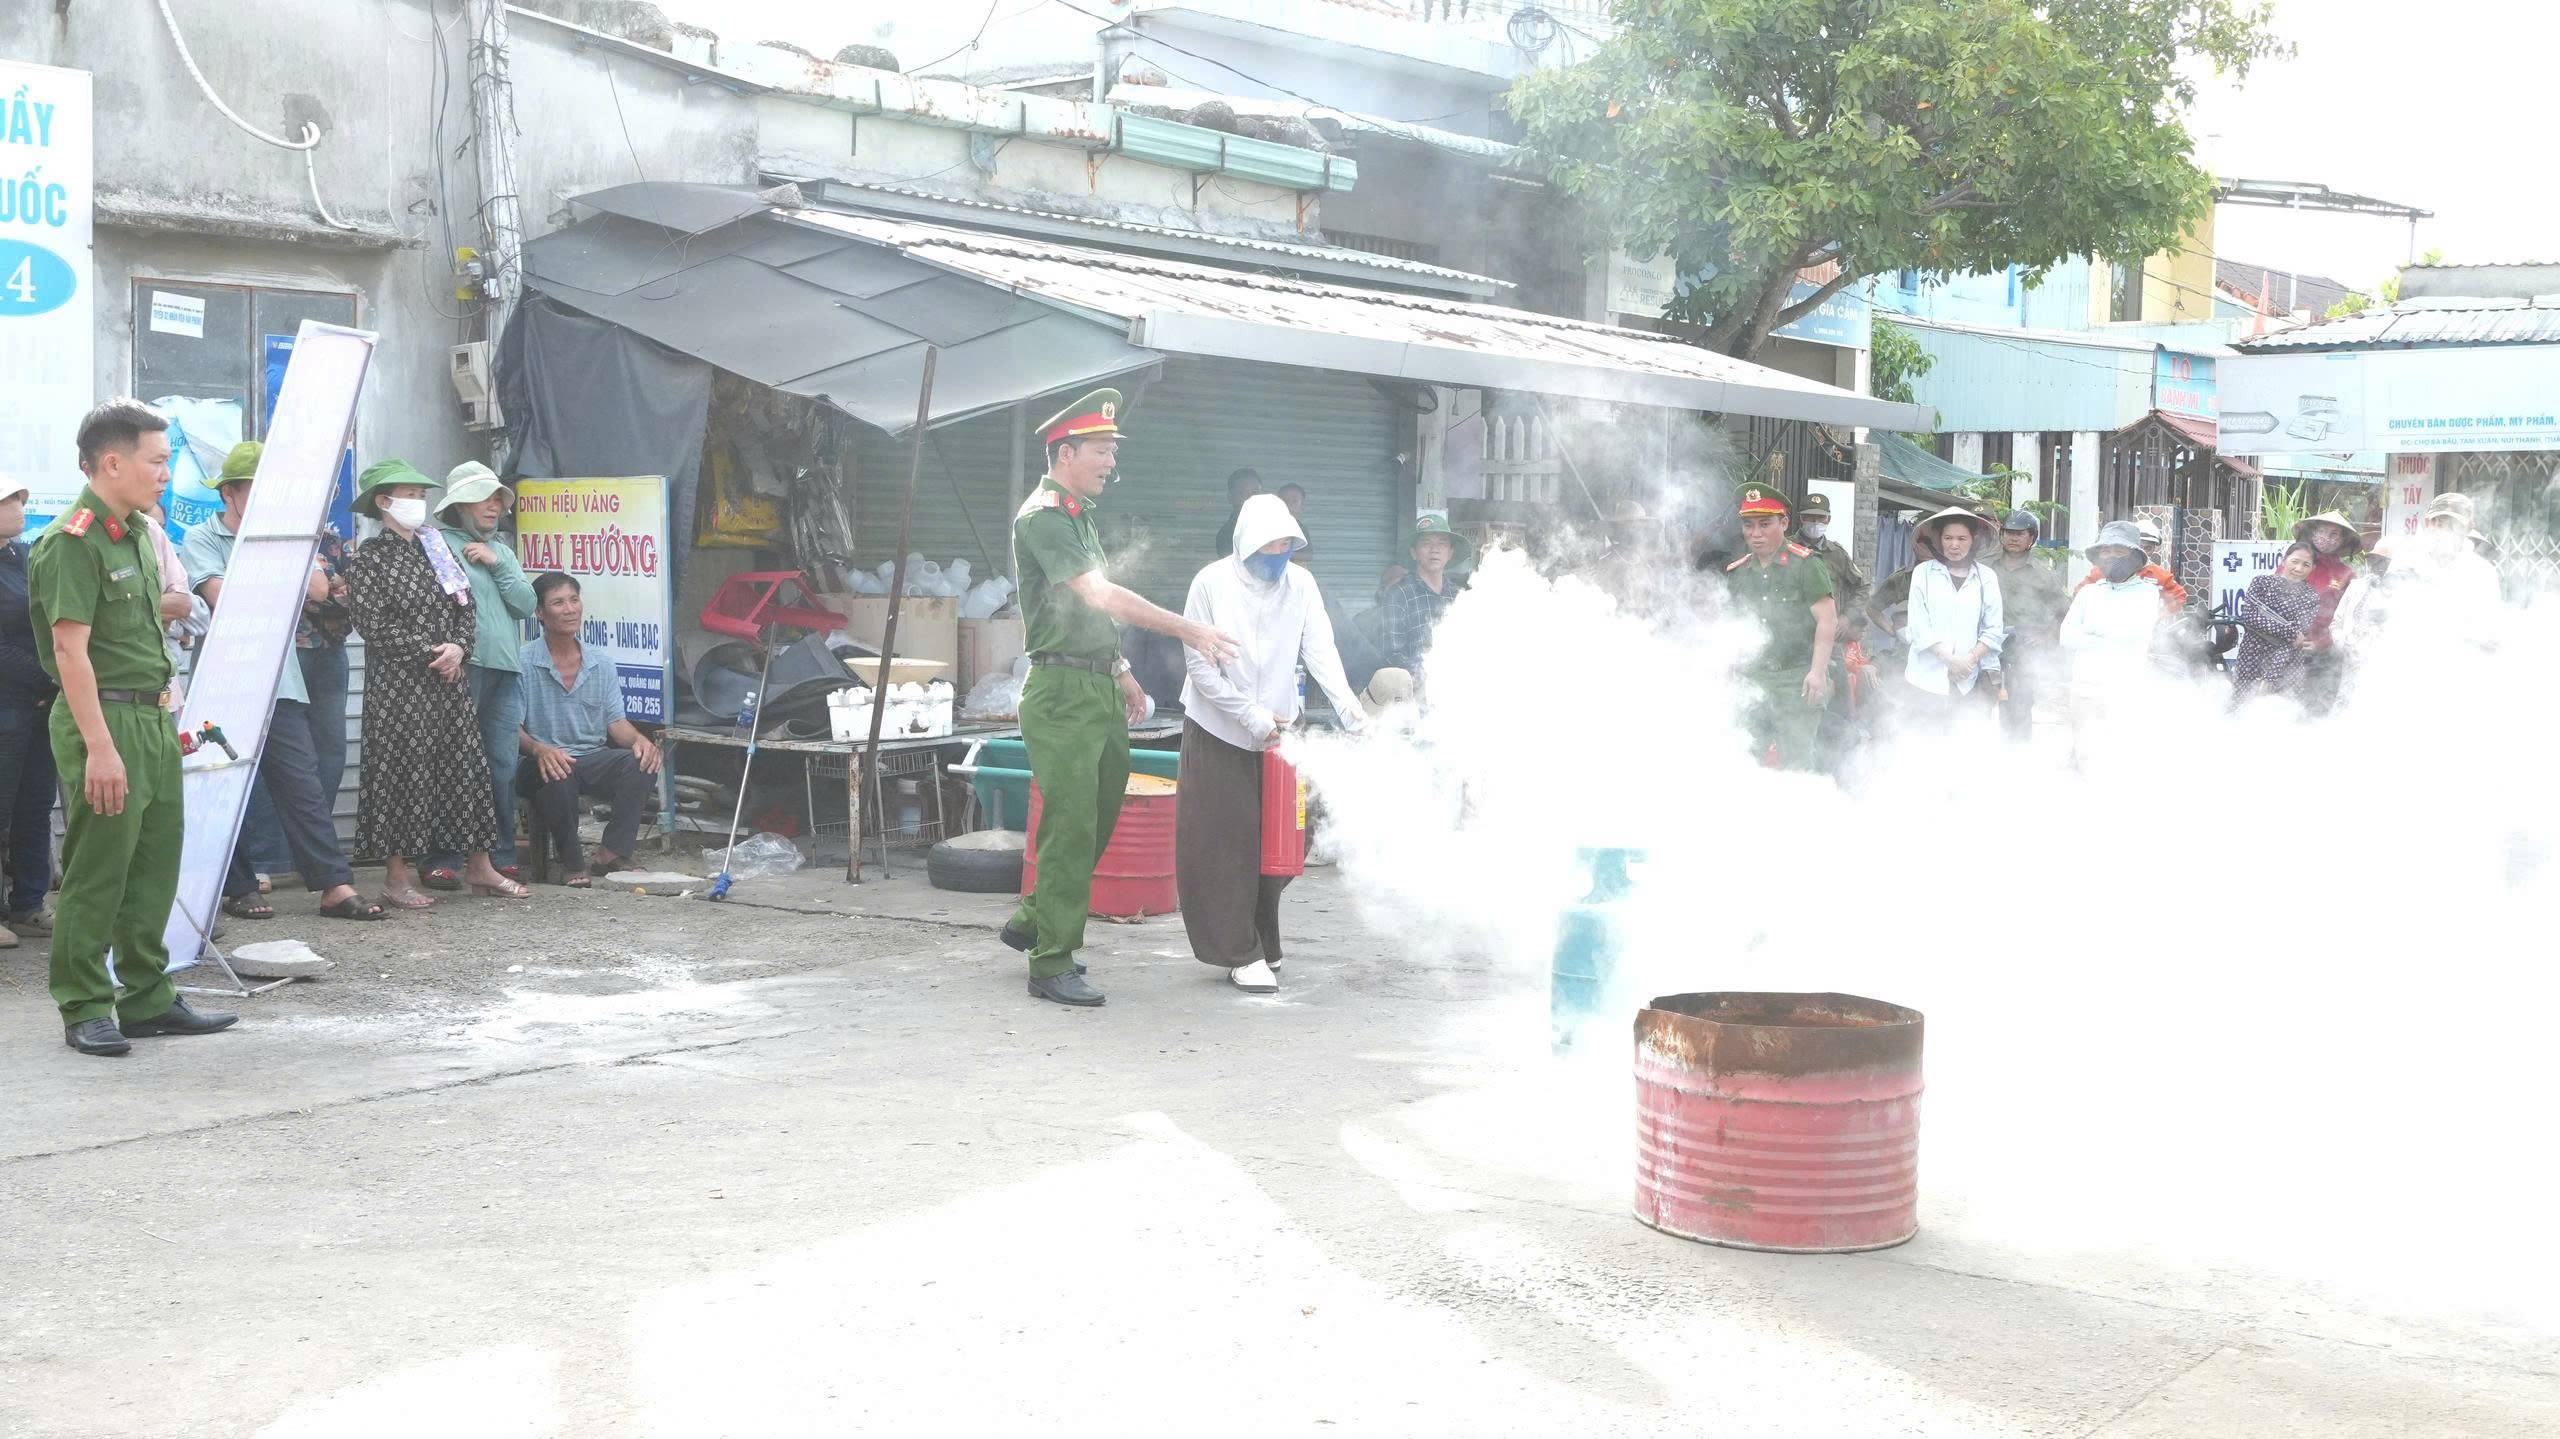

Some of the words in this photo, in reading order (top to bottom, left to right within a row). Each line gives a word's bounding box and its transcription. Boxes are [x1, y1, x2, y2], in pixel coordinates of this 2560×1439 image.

[0, 256, 37, 303] 4
[170, 511, 204, 525] SWEA
[519, 495, 547, 513] DNTN
[551, 489, 578, 519] HIỆU
[583, 488, 620, 513] VÀNG
[521, 533, 565, 573] MAI
[583, 615, 608, 647] CÔNG
[616, 617, 639, 649] VÀNG
[641, 622, 659, 656] BẠC
[648, 678, 661, 691] NAM
[627, 695, 643, 714] 266
[644, 696, 661, 715] 255
